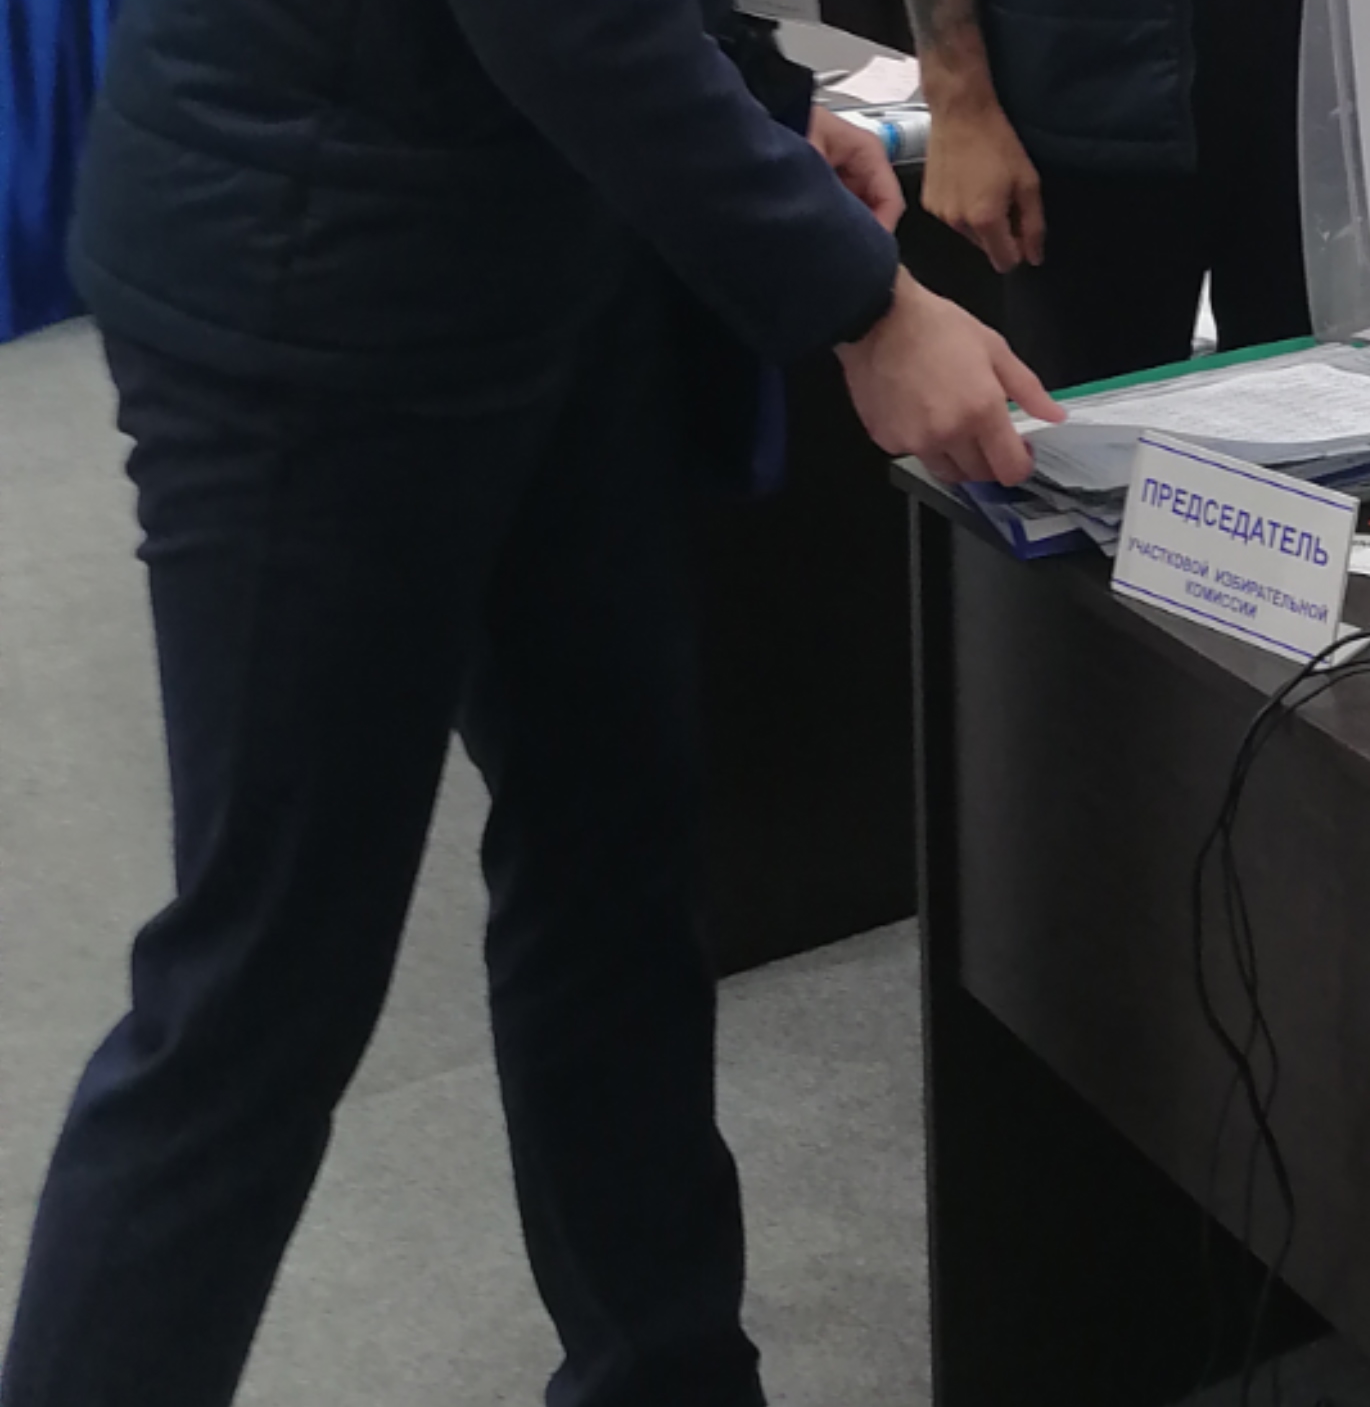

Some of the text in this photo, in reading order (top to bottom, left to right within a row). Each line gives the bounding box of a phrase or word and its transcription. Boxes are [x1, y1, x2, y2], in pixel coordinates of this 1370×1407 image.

[1141, 477, 1330, 567] ПРЕДСЕДАТЕЛЬ
[1128, 536, 1329, 624] УЧАСТКОВОЙ ИЗБИРАТЕЛЬНОЙ
[1185, 580, 1258, 619] КОМИССИИ
